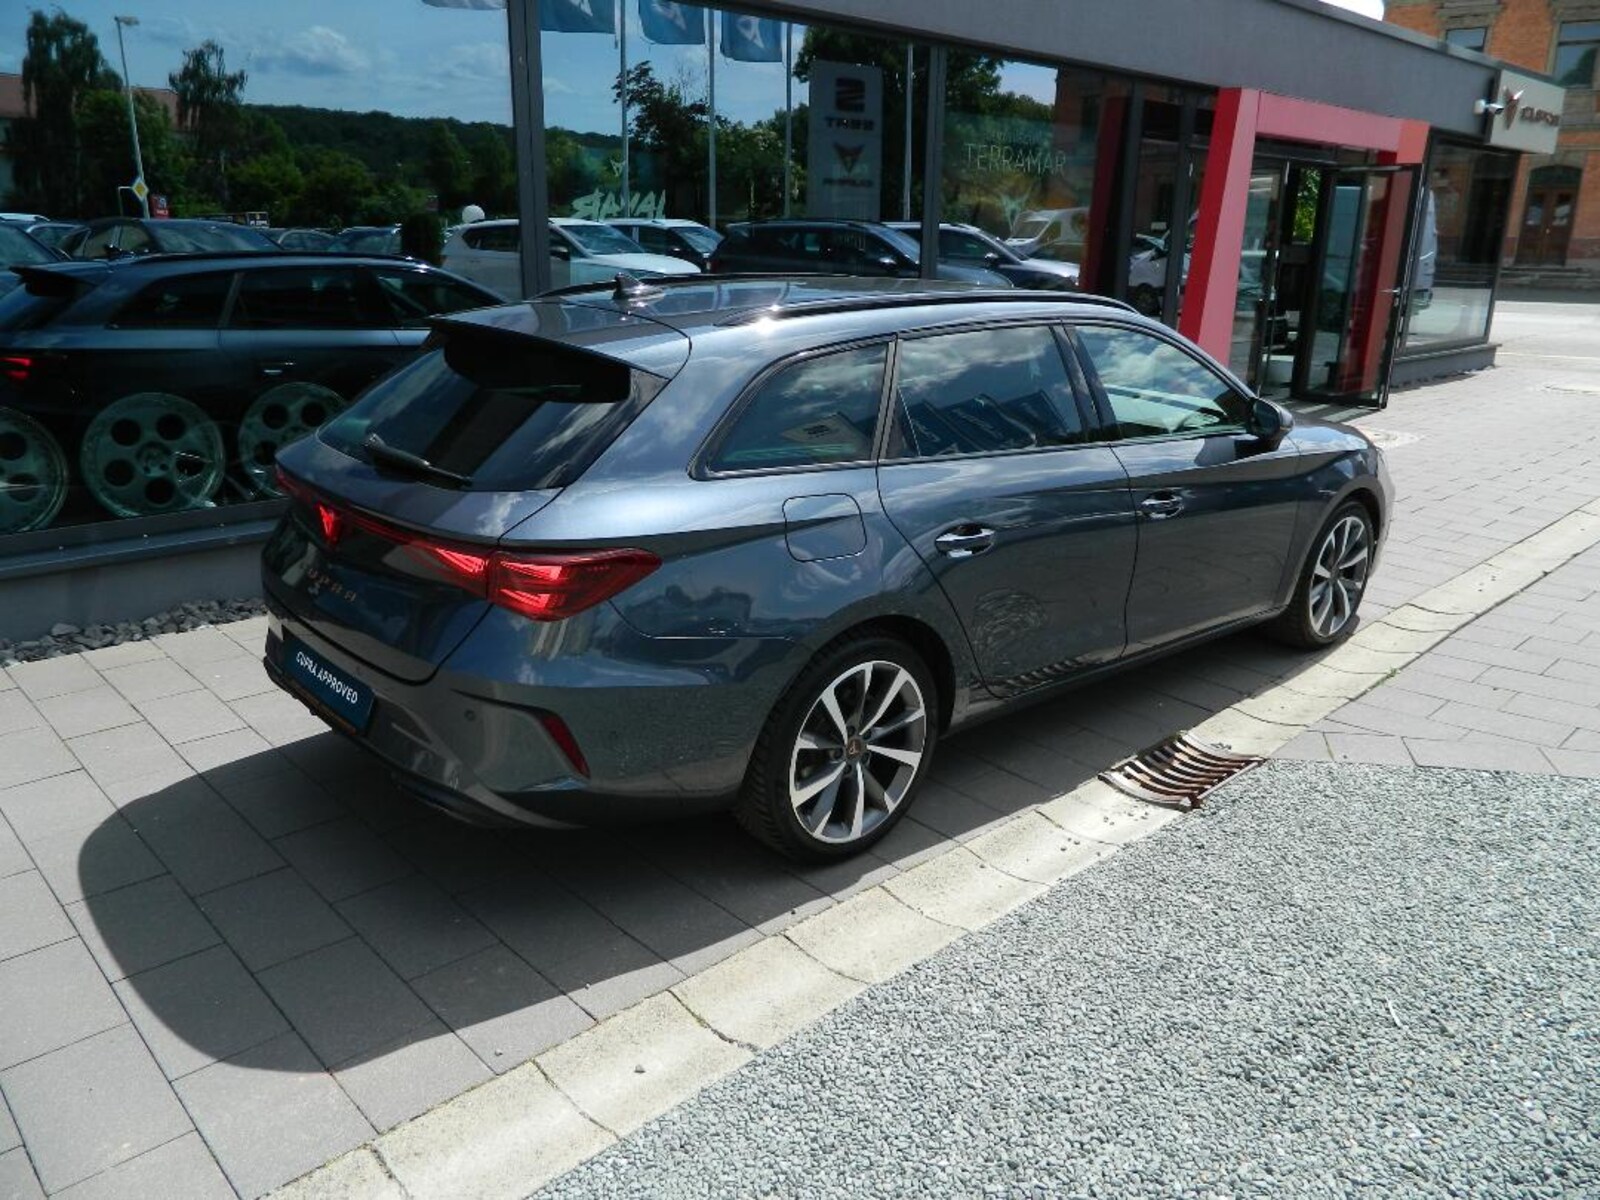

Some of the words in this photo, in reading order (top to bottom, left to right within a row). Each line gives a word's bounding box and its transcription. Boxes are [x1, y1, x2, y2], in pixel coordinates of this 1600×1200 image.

[964, 143, 1066, 176] TERRAMAR
[295, 651, 318, 676] CUPRA
[316, 668, 358, 704] APPROVED
